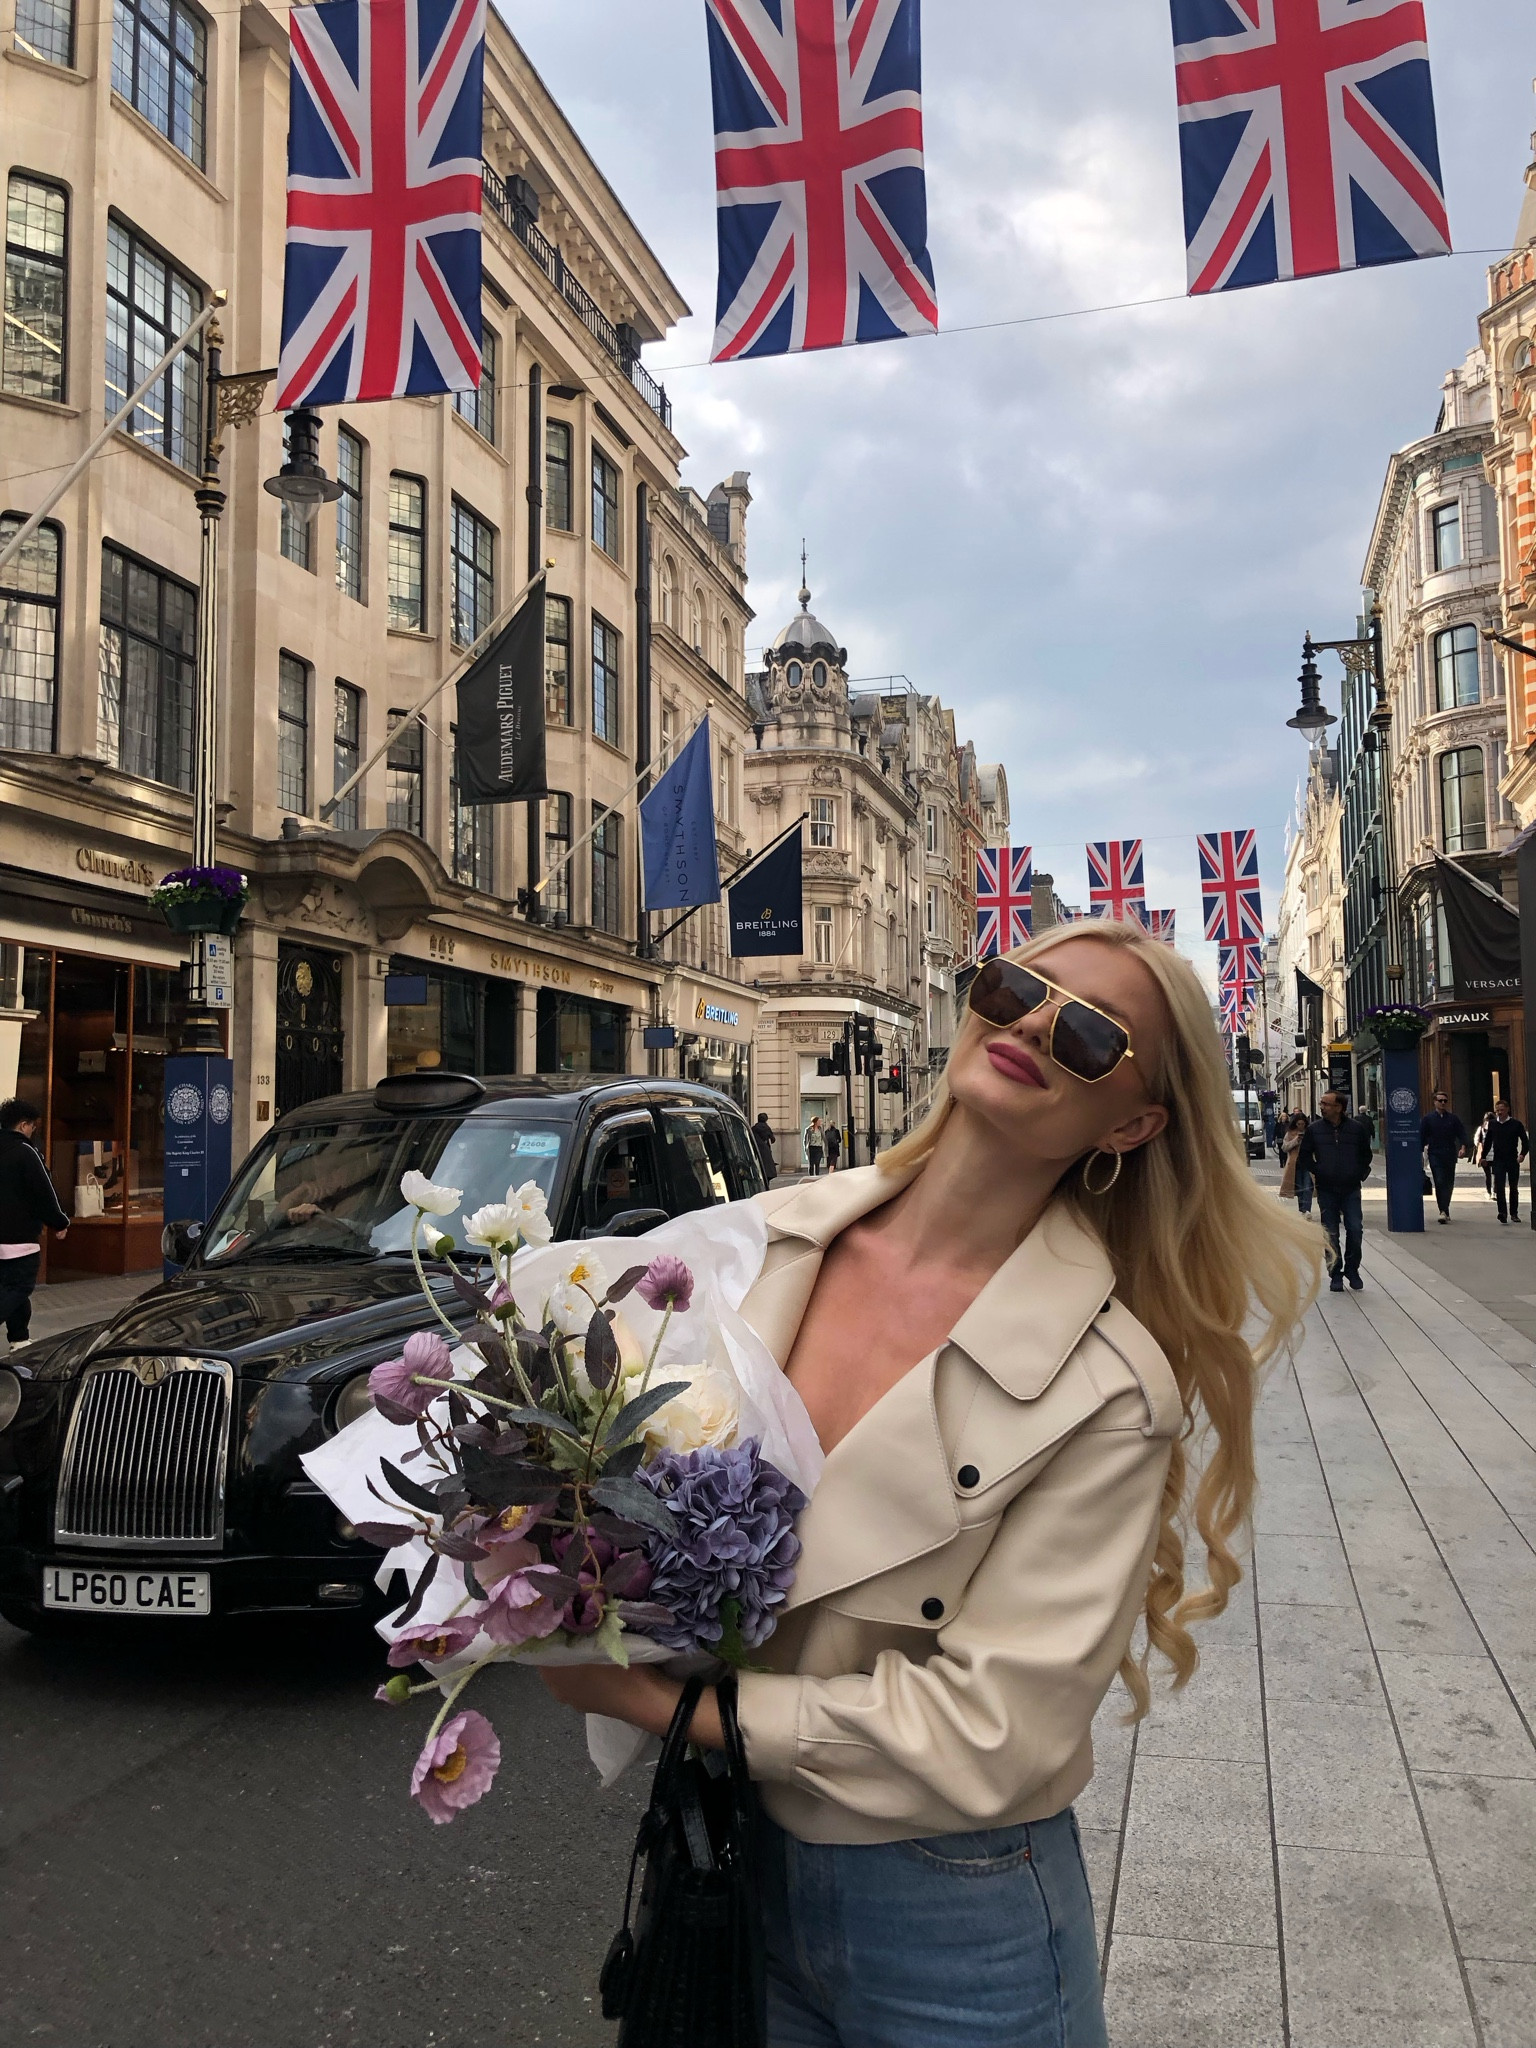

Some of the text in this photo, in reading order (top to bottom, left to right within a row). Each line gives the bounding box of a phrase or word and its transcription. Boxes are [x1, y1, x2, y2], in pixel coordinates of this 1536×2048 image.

[496, 664, 514, 783] AUDEMARS PIGUET
[674, 784, 689, 902] SMYTHSON
[76, 847, 154, 887] Church's
[71, 907, 132, 933] Church's
[736, 920, 798, 930] BREITLING
[490, 952, 571, 985] SMYTHSON
[1465, 978, 1521, 989] VERSACE
[704, 1004, 739, 1026] BREITLING
[1438, 1012, 1490, 1025] DELVAUX
[823, 1030, 836, 1039] 129
[257, 1075, 270, 1085] 133
[54, 1571, 196, 1608] LP60 CAE
